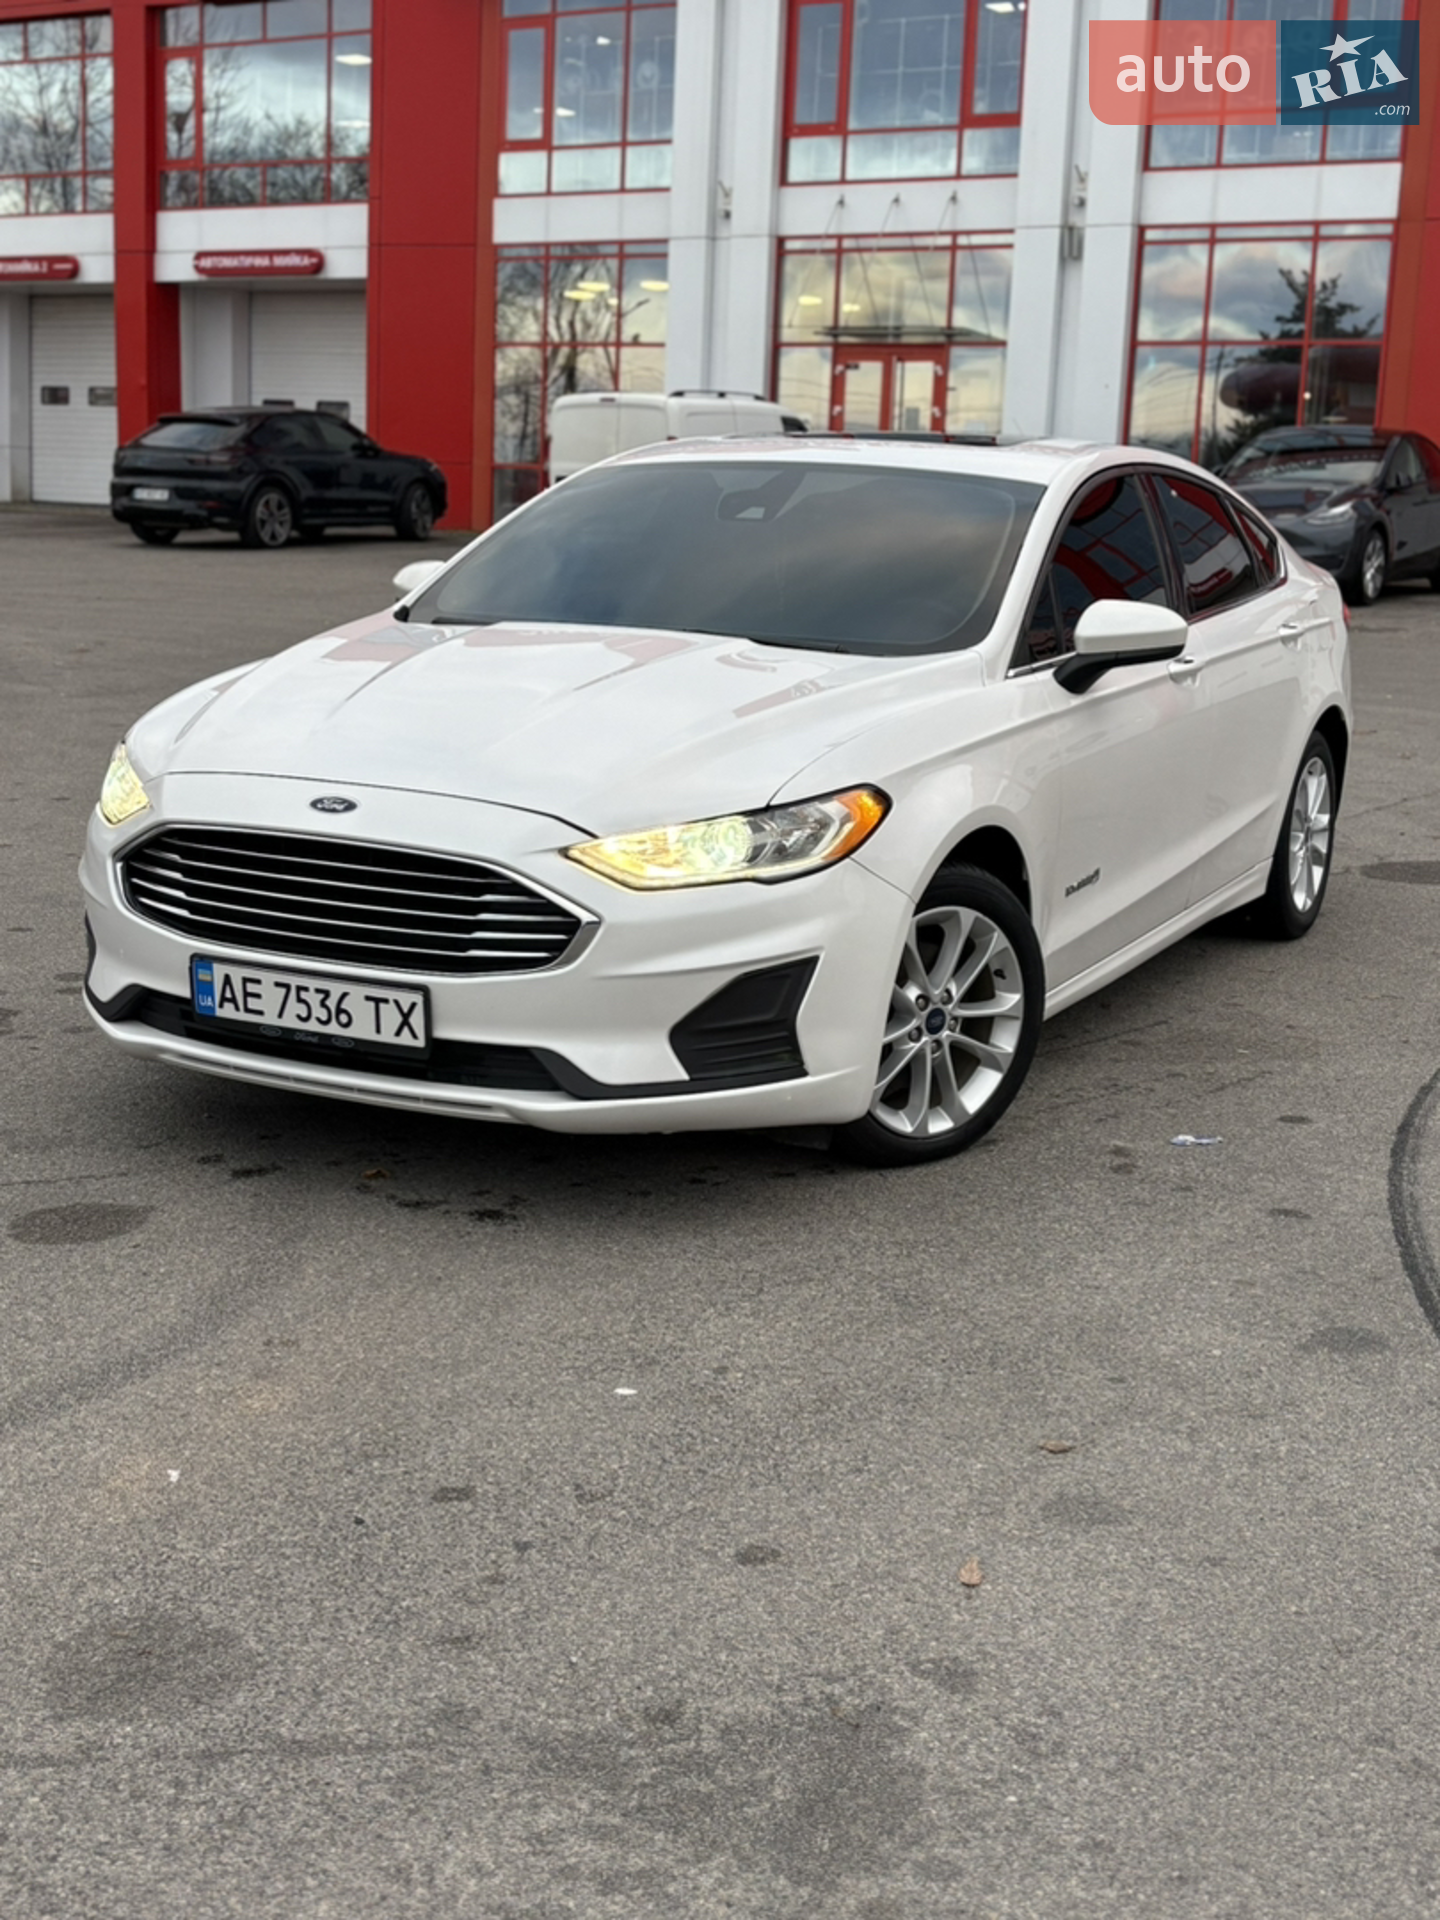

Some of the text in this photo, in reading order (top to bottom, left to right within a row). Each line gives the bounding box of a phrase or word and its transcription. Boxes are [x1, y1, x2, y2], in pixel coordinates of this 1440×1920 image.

[198, 995, 214, 1008] UA
[218, 973, 419, 1041] AE 7536 TX
